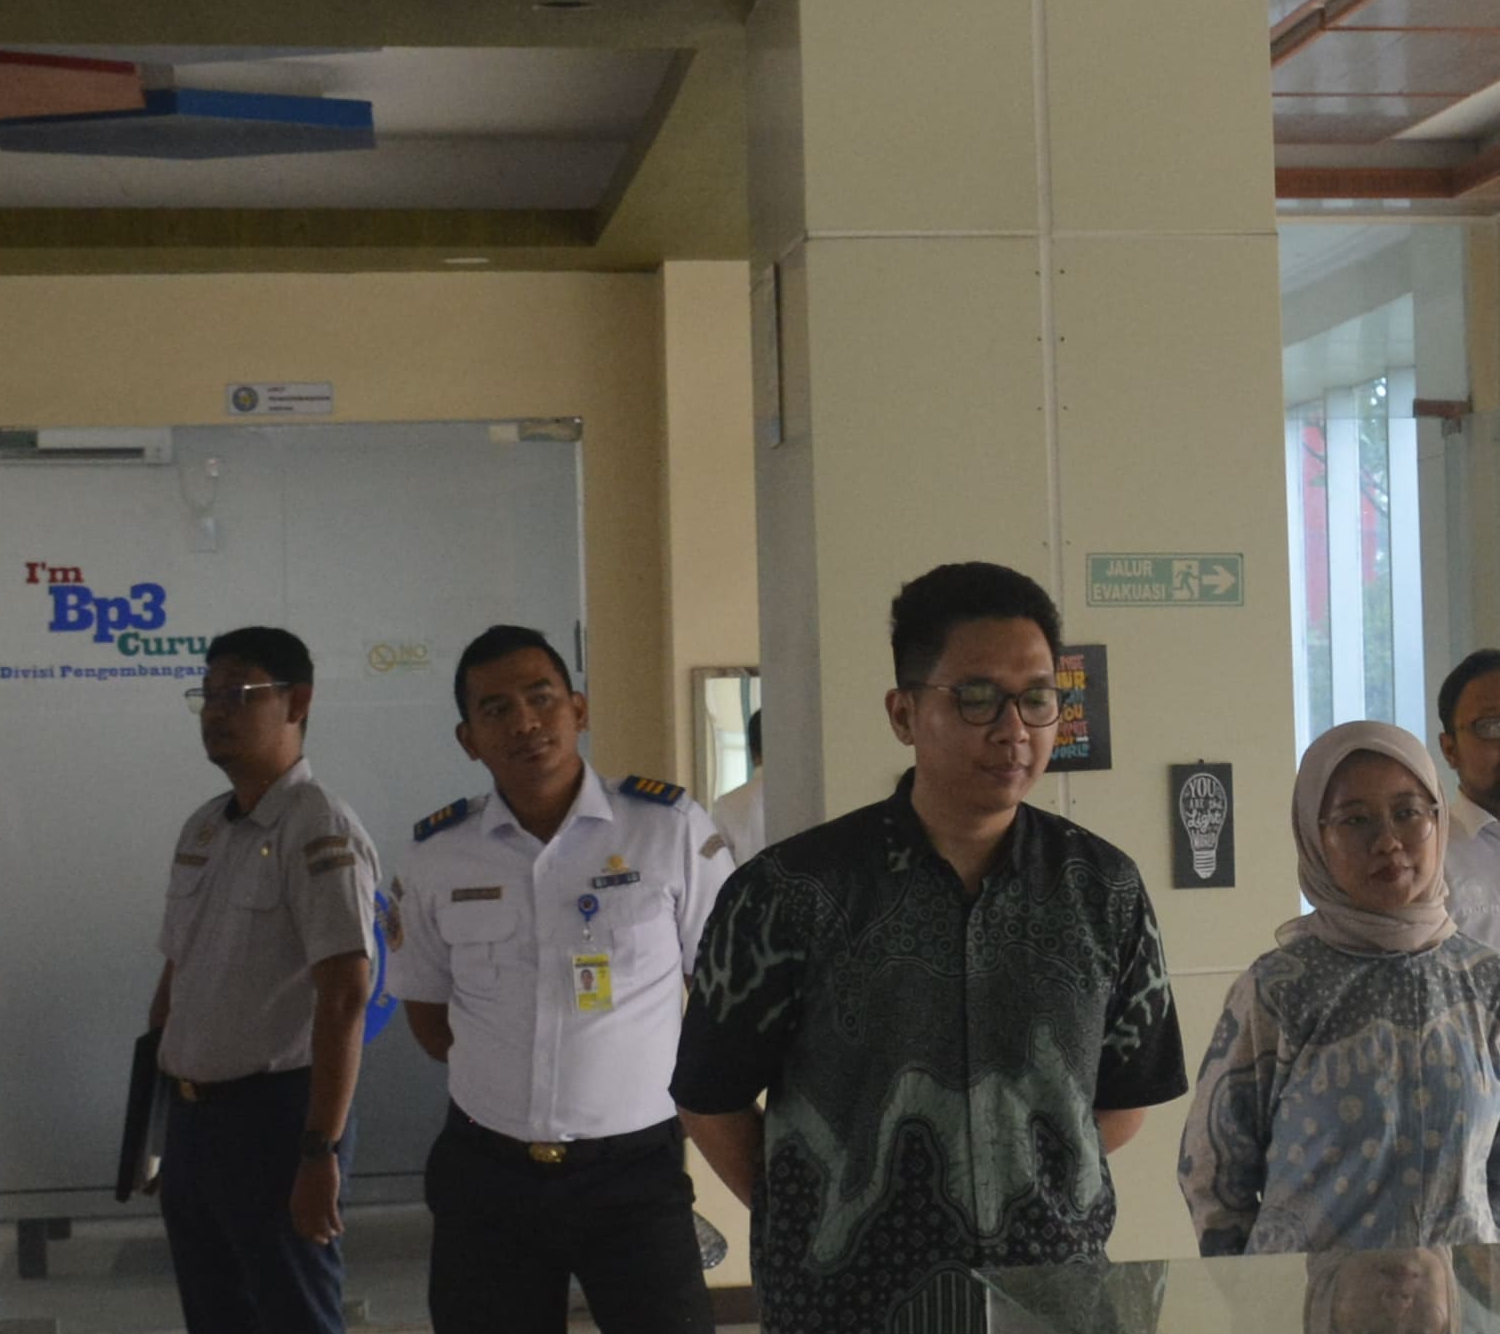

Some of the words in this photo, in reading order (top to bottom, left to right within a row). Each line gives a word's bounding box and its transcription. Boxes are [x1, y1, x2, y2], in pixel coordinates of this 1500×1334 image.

[24, 561, 84, 585] I'm
[1106, 560, 1153, 577] JALUR
[1093, 583, 1166, 601] EVAKUASI
[47, 582, 168, 644] Bp3
[116, 631, 209, 657] Curu
[1189, 777, 1216, 798] YOU
[1186, 809, 1222, 833] Light
